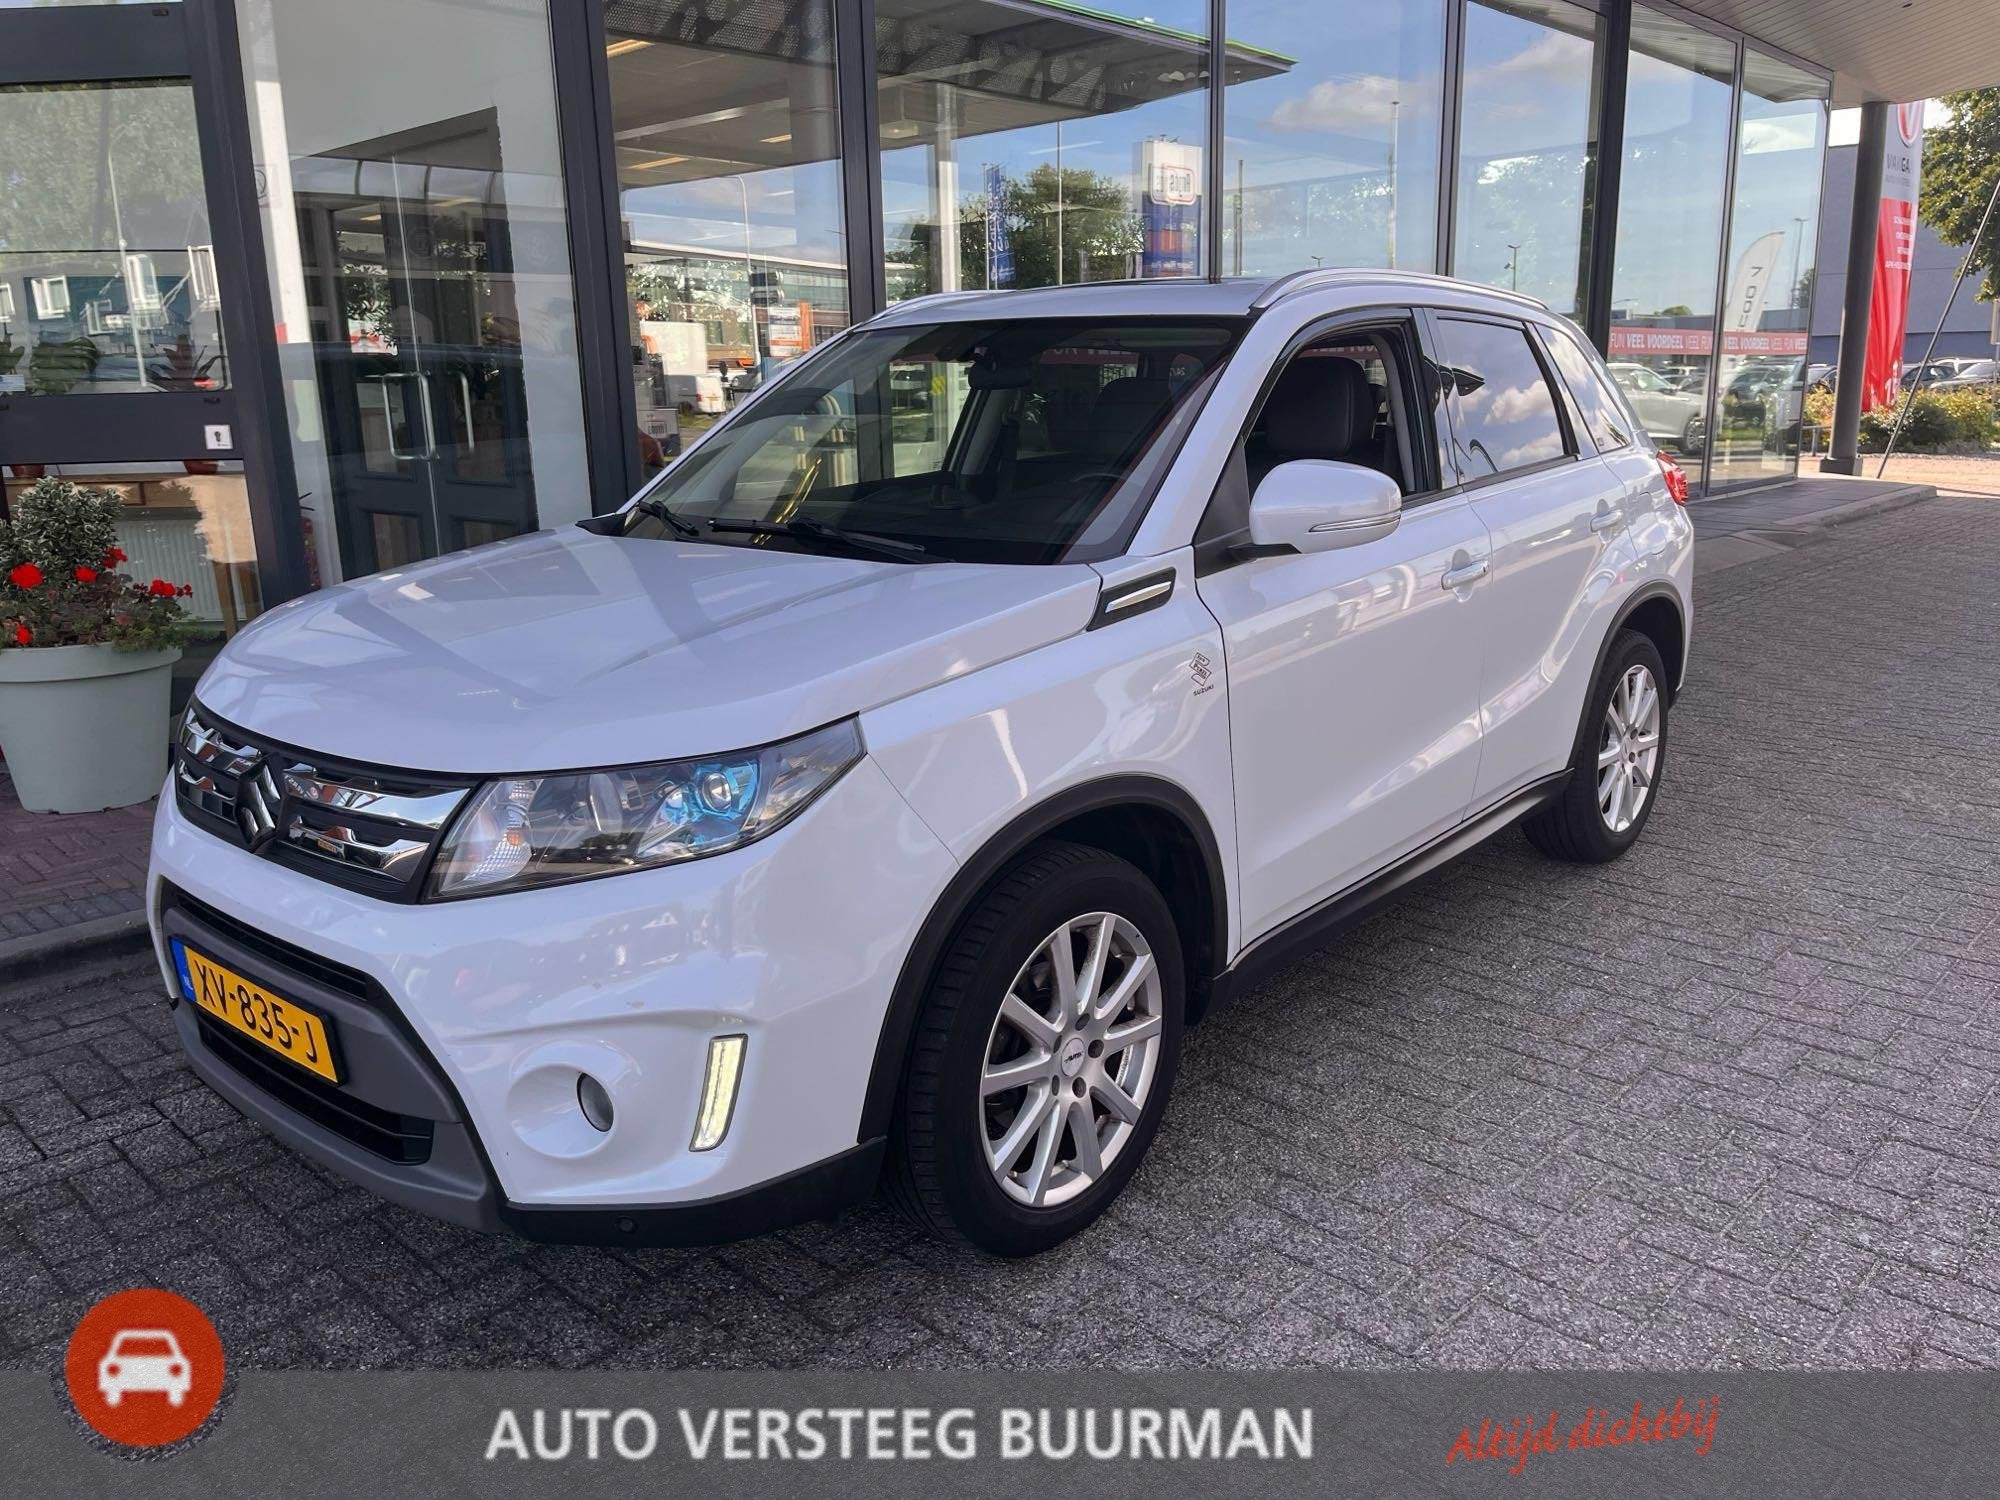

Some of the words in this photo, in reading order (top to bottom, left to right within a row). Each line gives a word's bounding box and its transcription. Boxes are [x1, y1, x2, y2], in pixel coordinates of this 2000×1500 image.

[1626, 334, 1646, 349] VEEL
[1647, 335, 1684, 349] VOORDEEL
[194, 959, 318, 1064] XV-835-J
